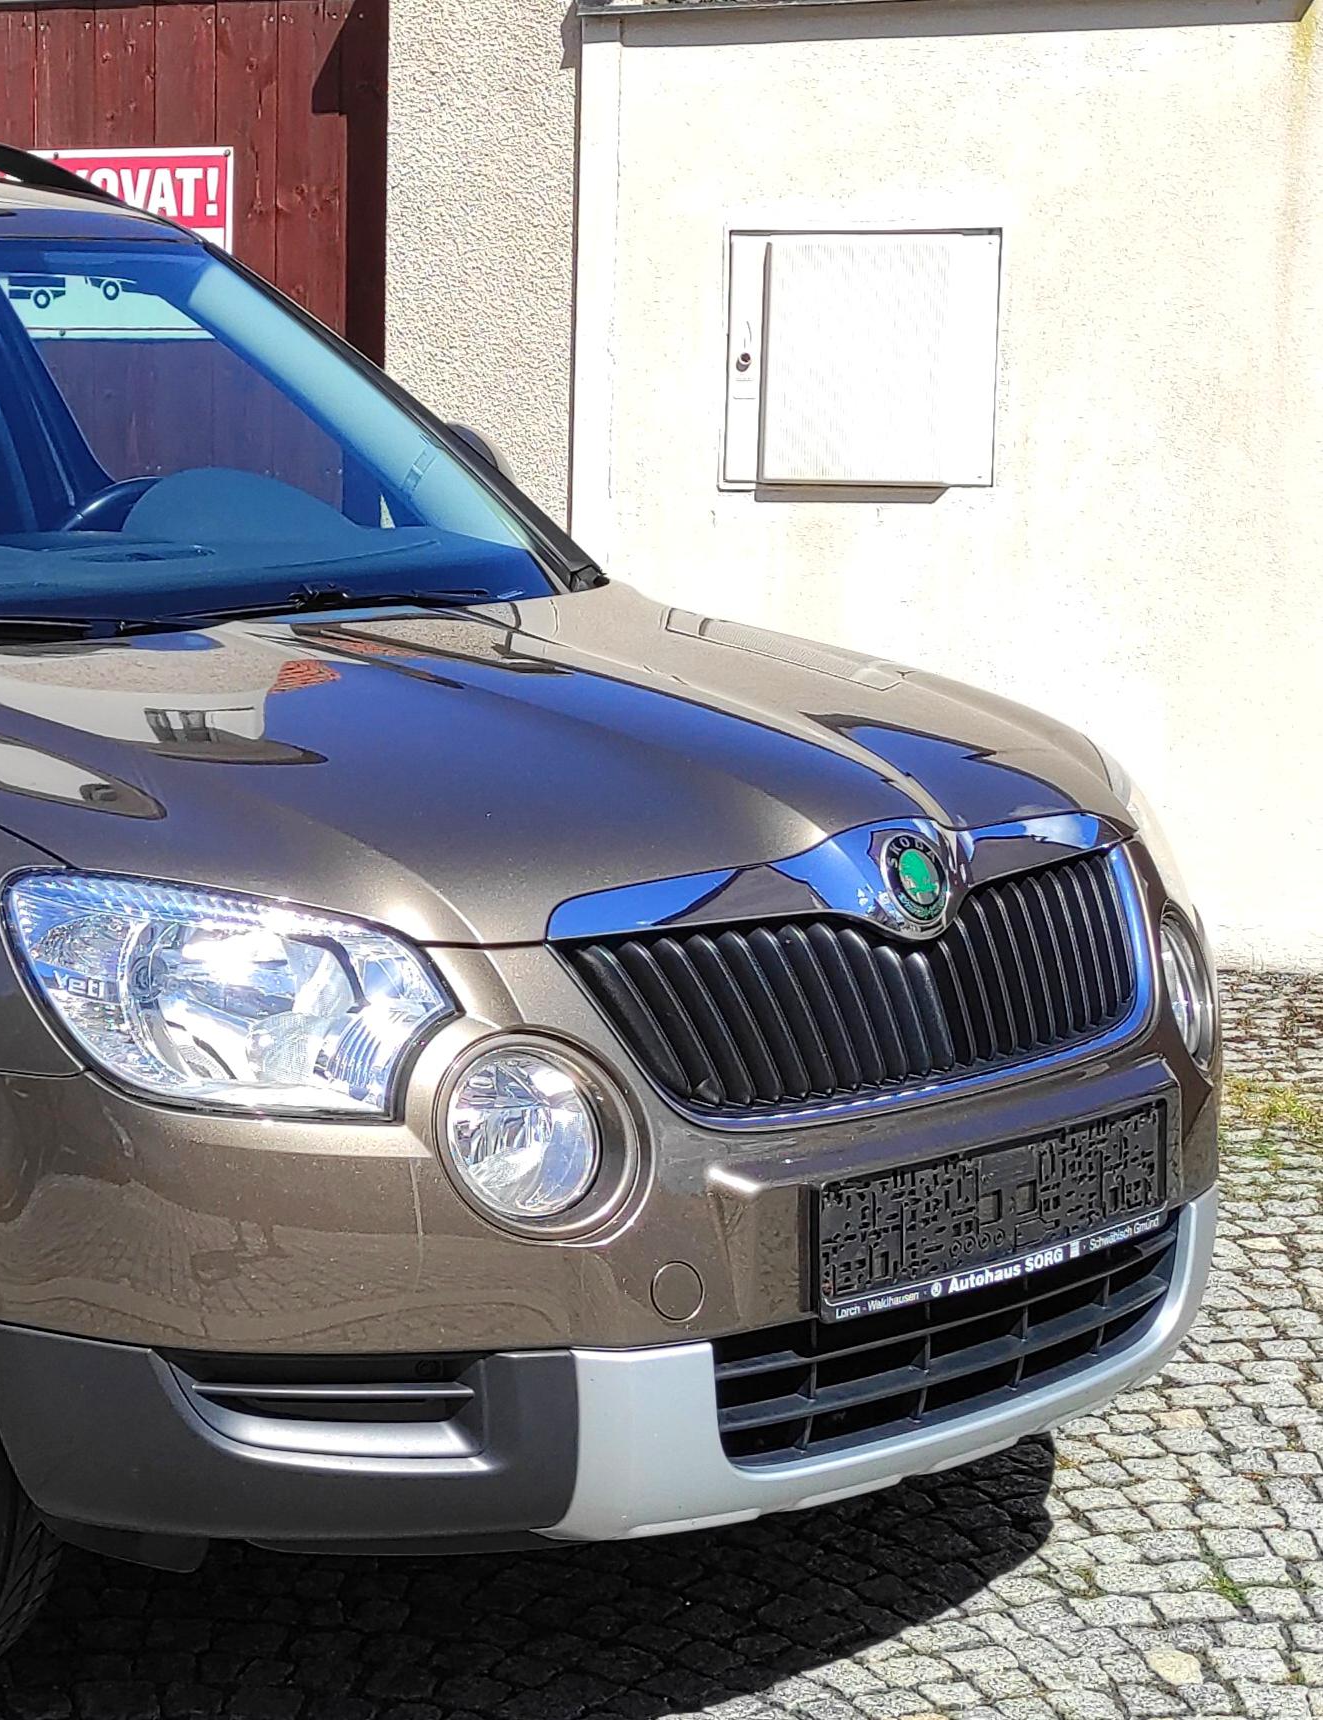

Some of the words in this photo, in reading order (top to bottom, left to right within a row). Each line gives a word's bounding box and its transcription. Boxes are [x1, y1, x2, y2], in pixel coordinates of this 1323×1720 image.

[77, 167, 220, 217] OVAT!
[947, 1266, 1021, 1294] Autohaus
[1024, 1247, 1064, 1273] SORG
